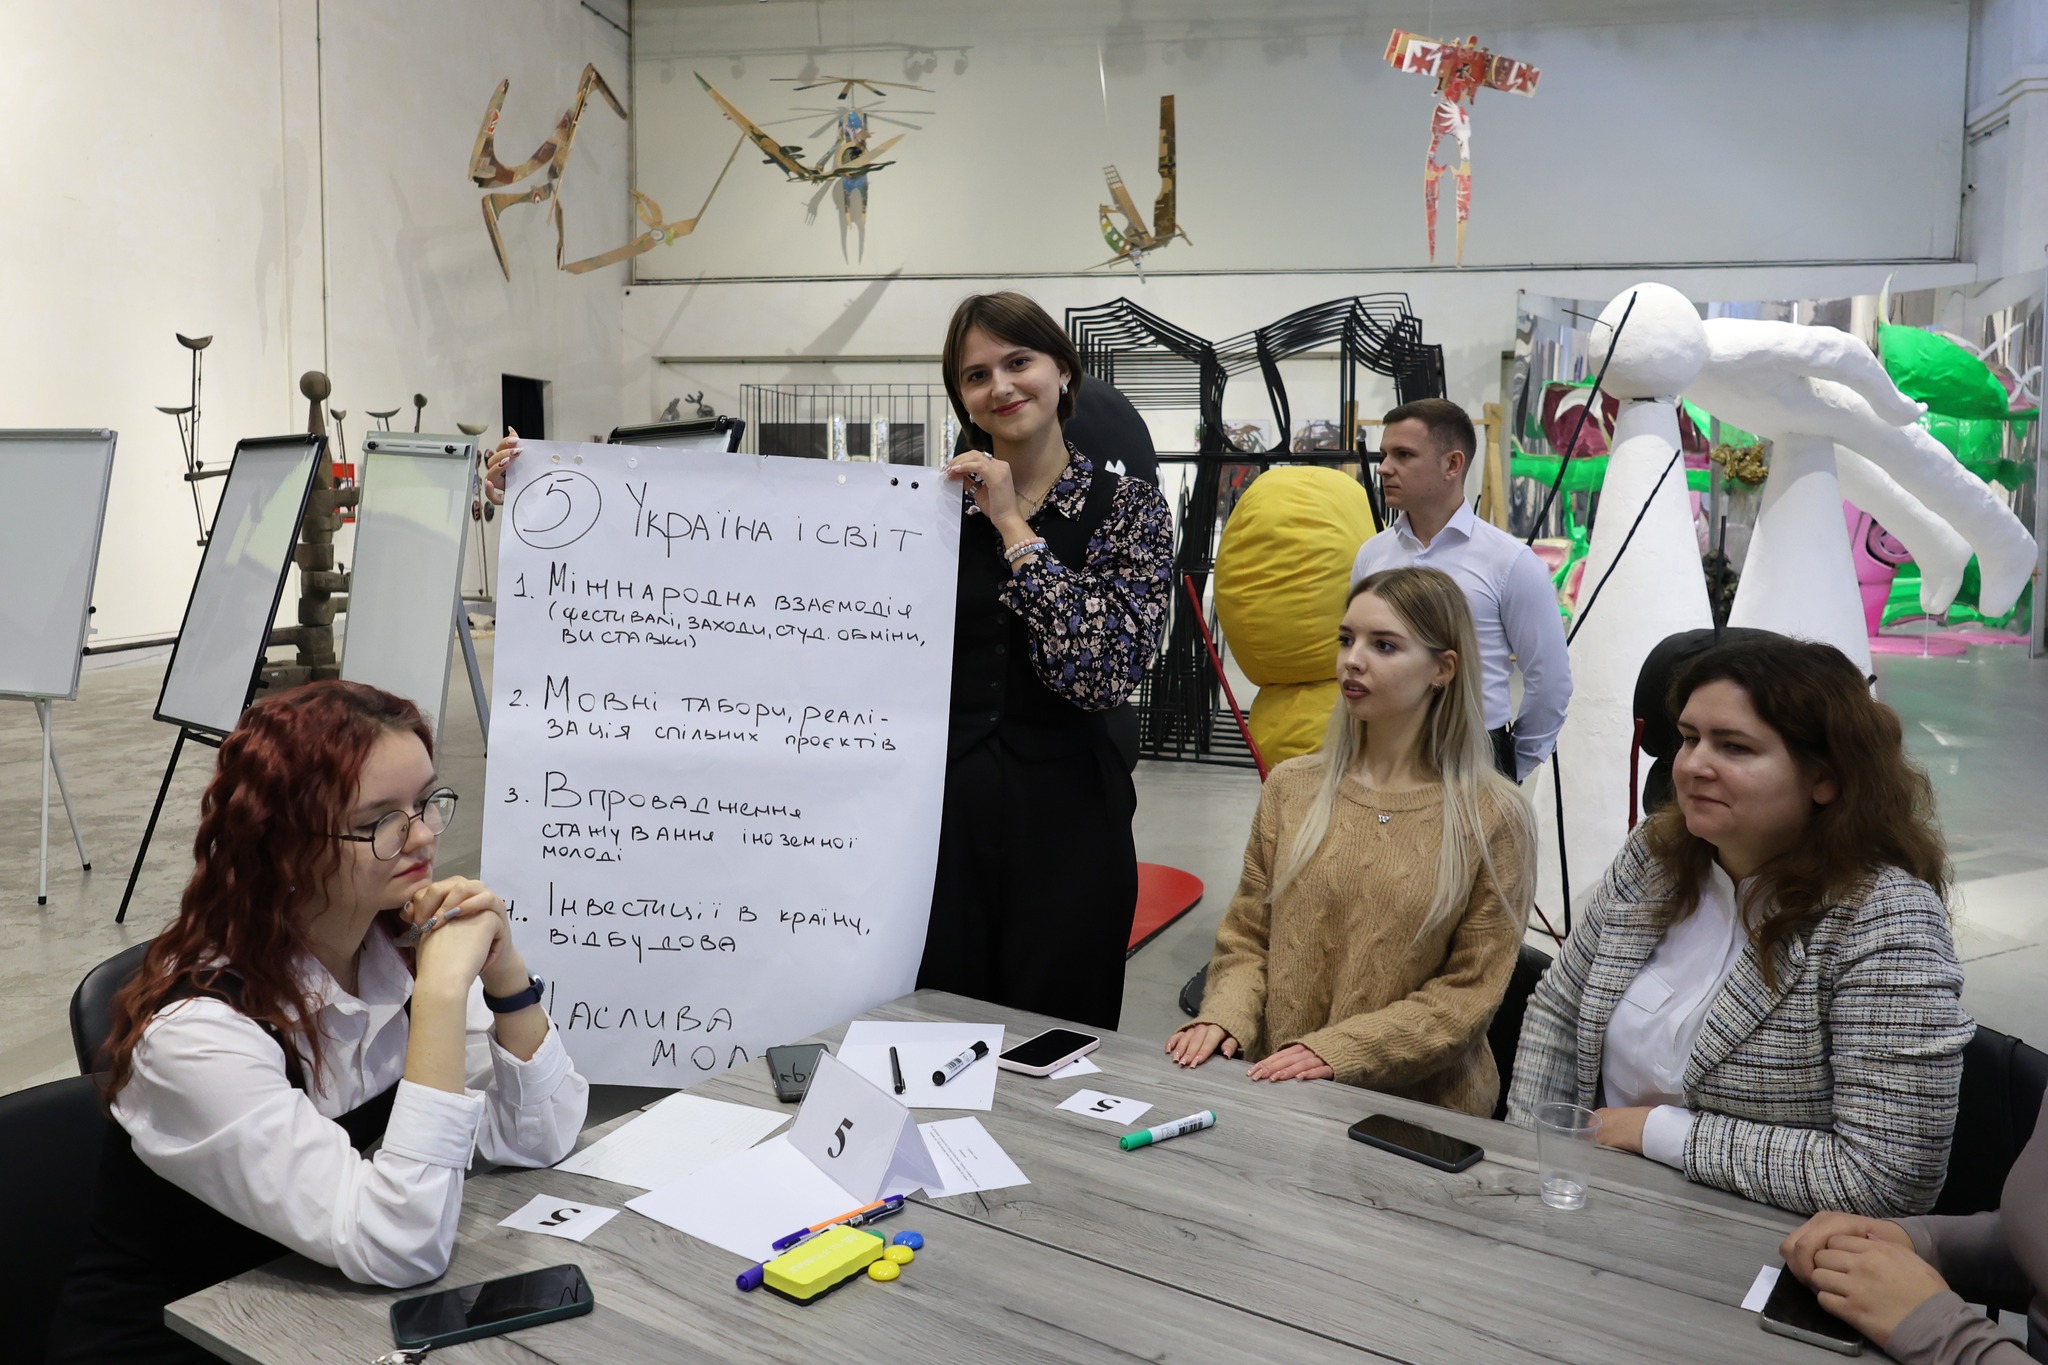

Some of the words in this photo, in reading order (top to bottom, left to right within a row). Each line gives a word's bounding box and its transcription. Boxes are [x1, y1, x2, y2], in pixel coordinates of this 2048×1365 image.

[523, 478, 574, 533] 5
[508, 688, 529, 708] 2.
[1089, 1099, 1121, 1112] 5
[827, 1117, 854, 1159] 5
[538, 1208, 581, 1226] 5
